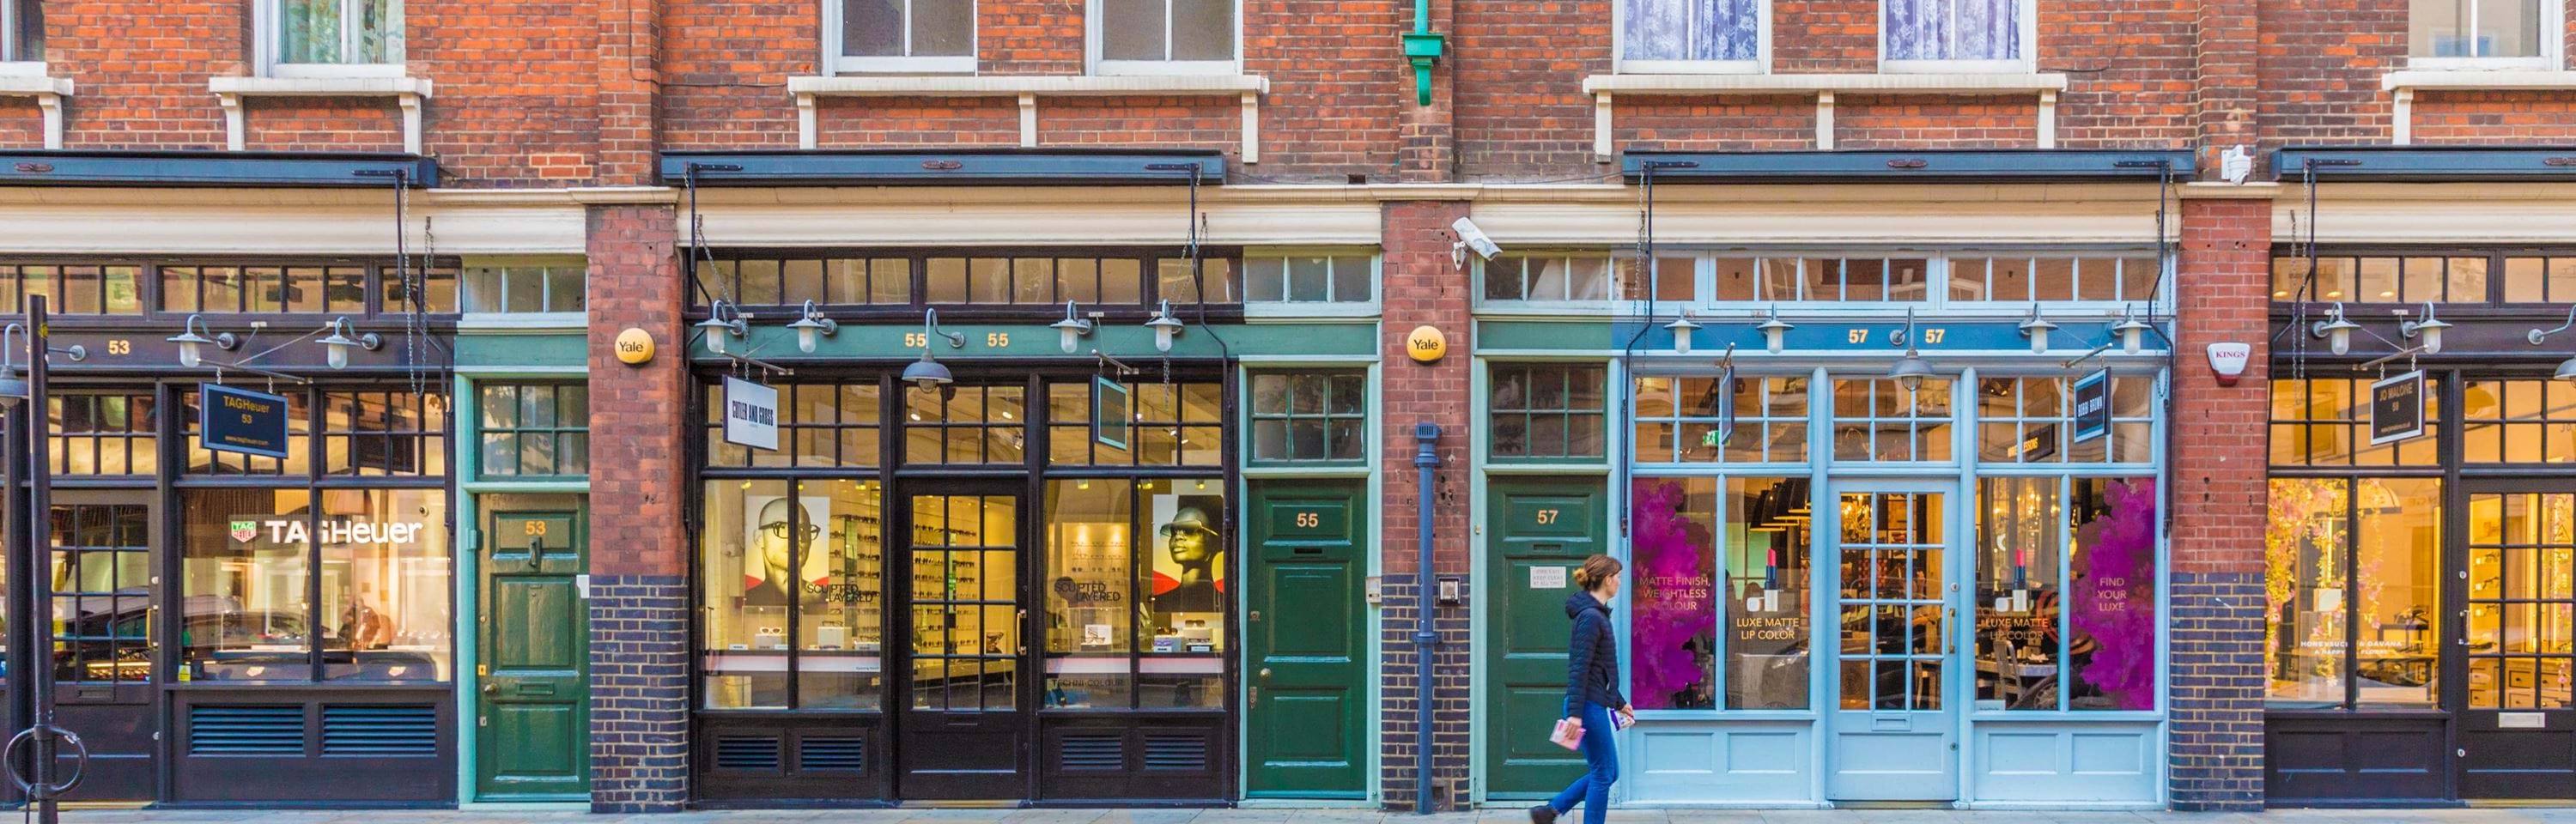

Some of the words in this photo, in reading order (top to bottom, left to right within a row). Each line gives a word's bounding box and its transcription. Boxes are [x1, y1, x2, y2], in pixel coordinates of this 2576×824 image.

[904, 332, 926, 347] 55
[987, 332, 1009, 347] 55
[1849, 329, 1868, 343] 57
[1925, 329, 1945, 343] 57
[108, 340, 131, 354] 53
[619, 341, 643, 352] Yale
[1413, 339, 1438, 350] Yale
[223, 396, 270, 413] TAGHeuer
[2078, 400, 2089, 417] BOBBI
[2089, 396, 2103, 413] BROWN
[241, 414, 252, 424] 53
[732, 400, 748, 421] CUTLER
[748, 403, 758, 423] AND
[758, 406, 774, 427] GROSS
[1297, 512, 1319, 528] 55
[1537, 509, 1558, 524] 57
[526, 520, 546, 536] 53
[1639, 577, 1674, 585] MATTE
[1675, 577, 1711, 587] FINISH,
[2099, 577, 2125, 586] FIND
[1643, 589, 1707, 598] WEIGHTLESS
[2097, 590, 2127, 600] YOUR
[1654, 601, 1698, 610] COLOUR
[2099, 603, 2125, 612] LUXE
[1736, 617, 1762, 627] LUXE
[1765, 617, 1799, 627] MATTE
[1985, 618, 2011, 627] LUXE
[2014, 618, 2049, 627] MATTE
[1741, 630, 1755, 639] LIP
[1758, 630, 1795, 639] COLOR
[1990, 631, 2004, 640] LIP
[2007, 631, 2044, 640] COLOR
